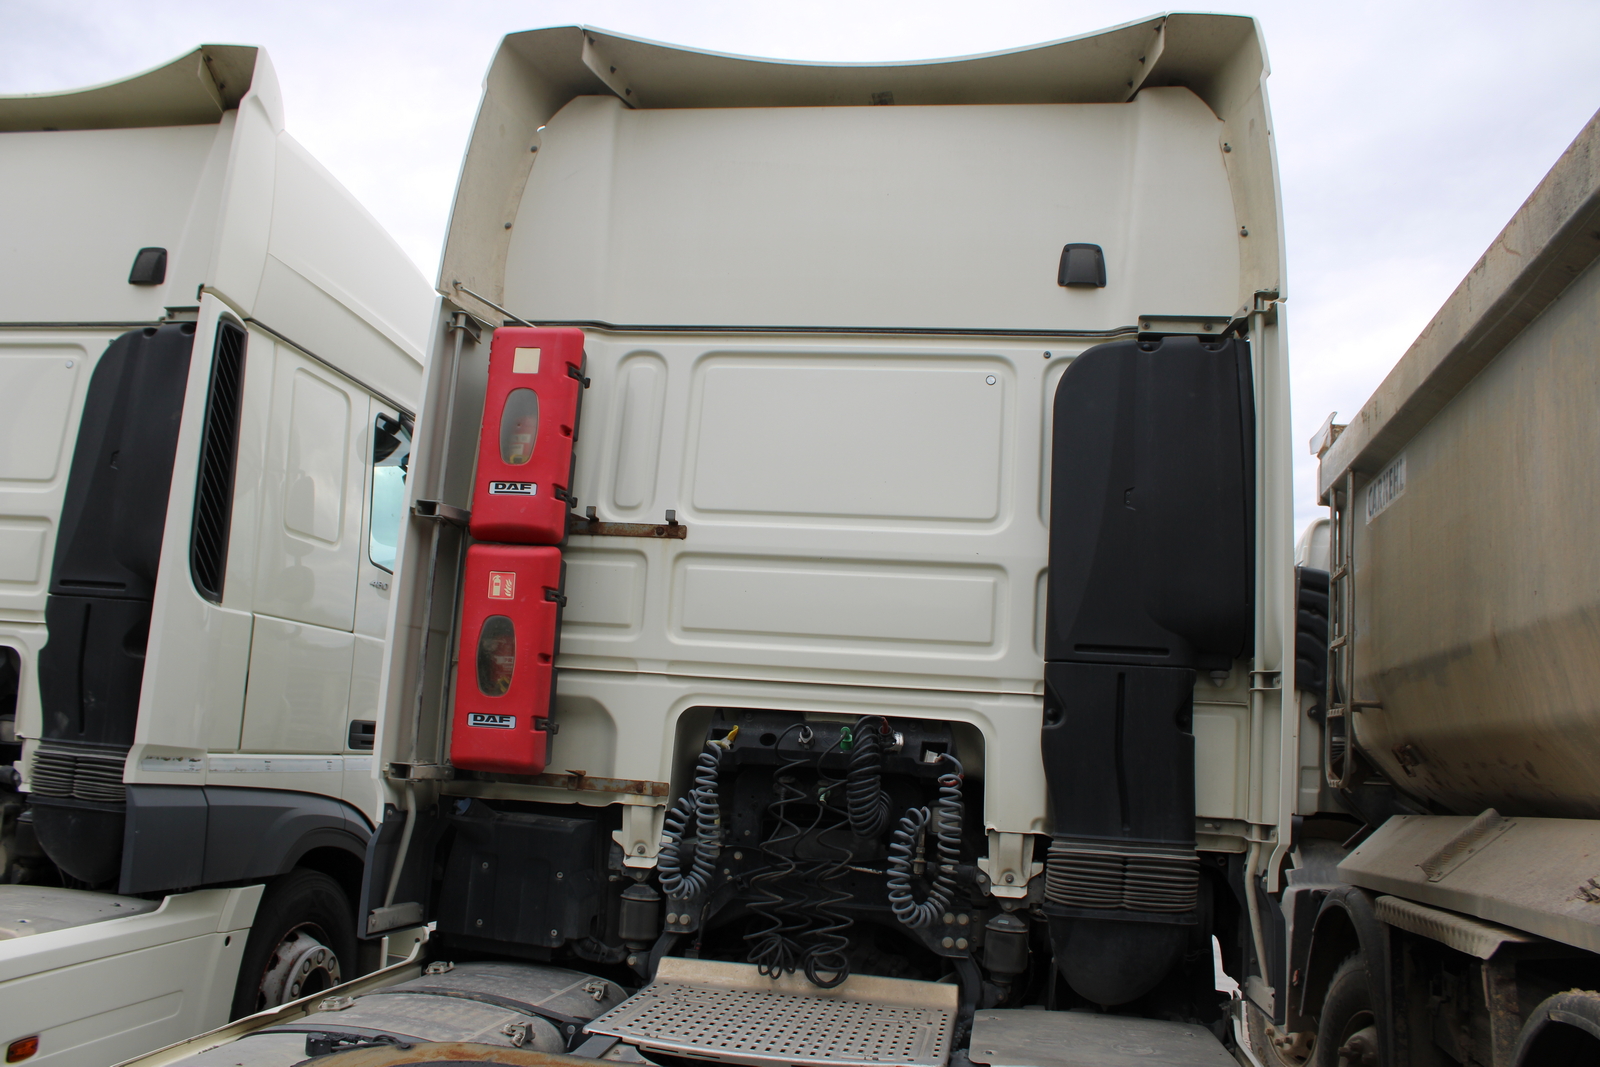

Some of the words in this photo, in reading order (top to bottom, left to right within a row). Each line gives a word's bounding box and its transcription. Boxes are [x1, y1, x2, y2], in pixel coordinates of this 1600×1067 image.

[494, 482, 532, 491] DAF
[1368, 458, 1404, 517] CARNEHL
[473, 714, 511, 723] DAF
